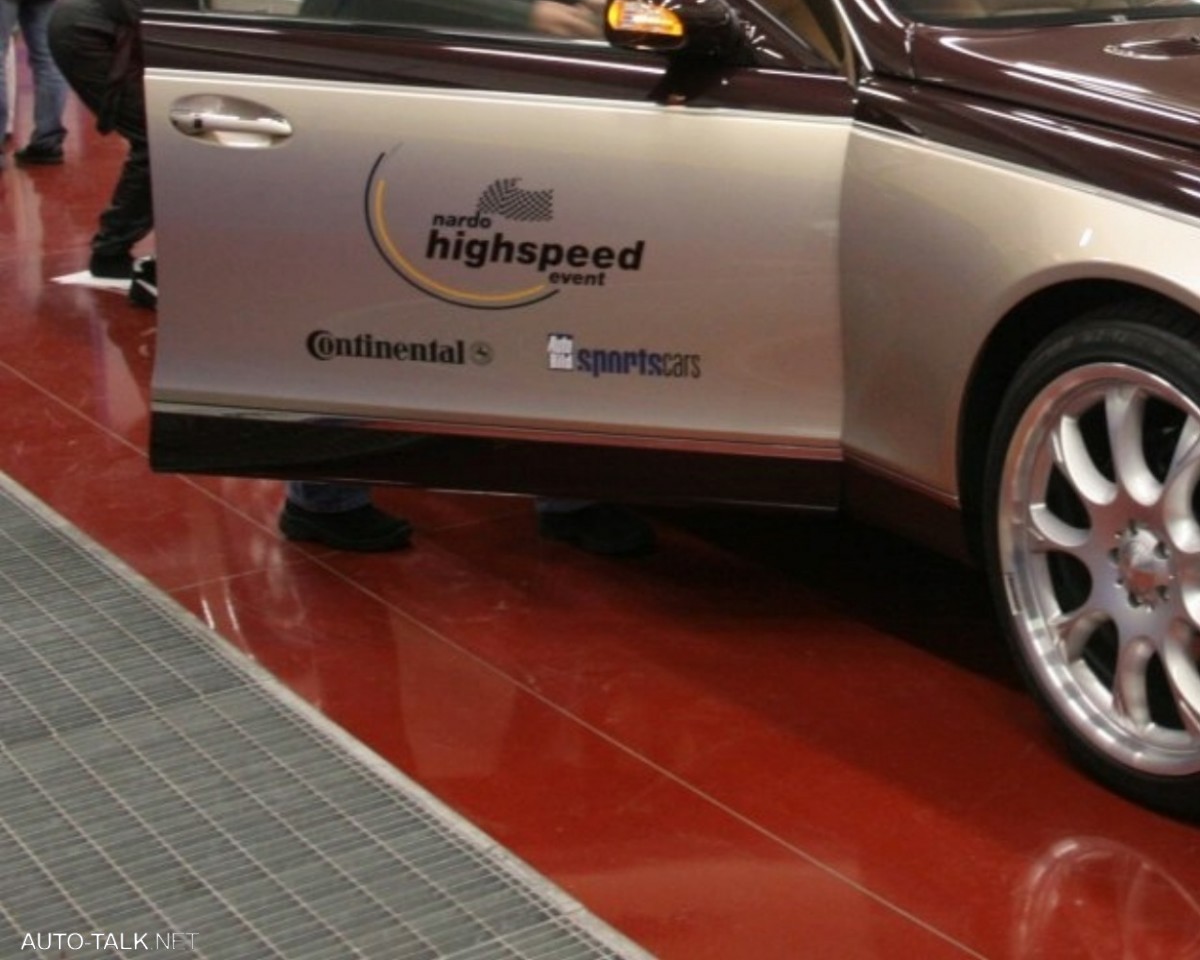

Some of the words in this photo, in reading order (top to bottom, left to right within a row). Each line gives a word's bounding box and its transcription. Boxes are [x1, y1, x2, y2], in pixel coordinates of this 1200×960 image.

[432, 211, 492, 229] nardo
[425, 229, 645, 272] highspeed
[548, 271, 606, 287] event
[306, 329, 466, 365] Continental
[577, 348, 701, 379] sportscars
